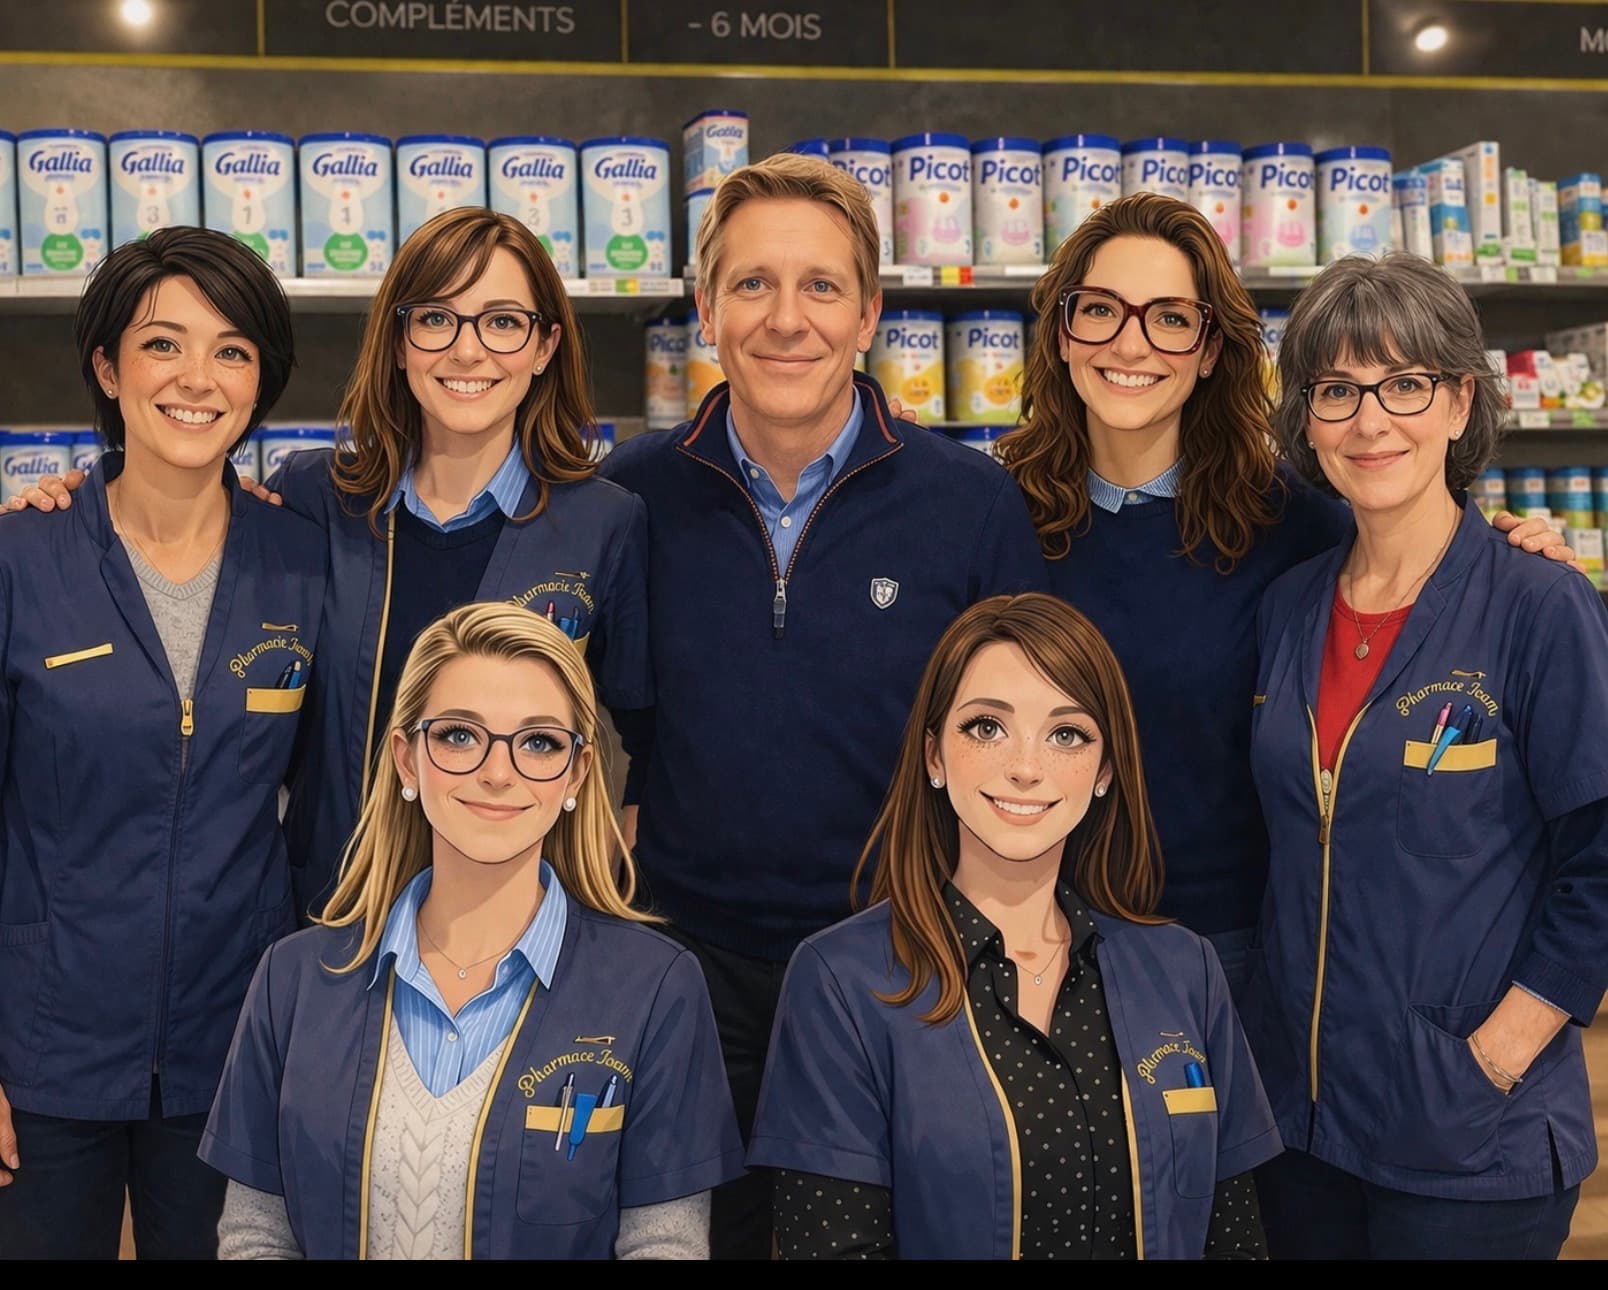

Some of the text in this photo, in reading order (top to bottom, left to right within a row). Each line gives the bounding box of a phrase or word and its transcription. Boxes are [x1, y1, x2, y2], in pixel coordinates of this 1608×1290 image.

[325, 0, 576, 34] COMPLÉMENTS
[711, 10, 731, 38] 6
[740, 11, 822, 41] MOIS
[1580, 26, 1608, 54] M
[29, 150, 92, 173] Gallia
[121, 150, 185, 174] Gallia
[215, 151, 281, 176] Gallia
[312, 153, 378, 177] Gallia
[409, 154, 473, 178] Gallia
[501, 156, 565, 179] Gallia
[594, 157, 657, 180] Gallia
[909, 154, 970, 182] Picot
[980, 159, 1041, 186] Picot
[1062, 155, 1120, 184] Picot
[1141, 158, 1188, 184] Pico
[1330, 166, 1389, 193] Picot
[886, 327, 939, 350] Picot
[968, 327, 1020, 350] Picot
[4, 456, 60, 477] Gallia
